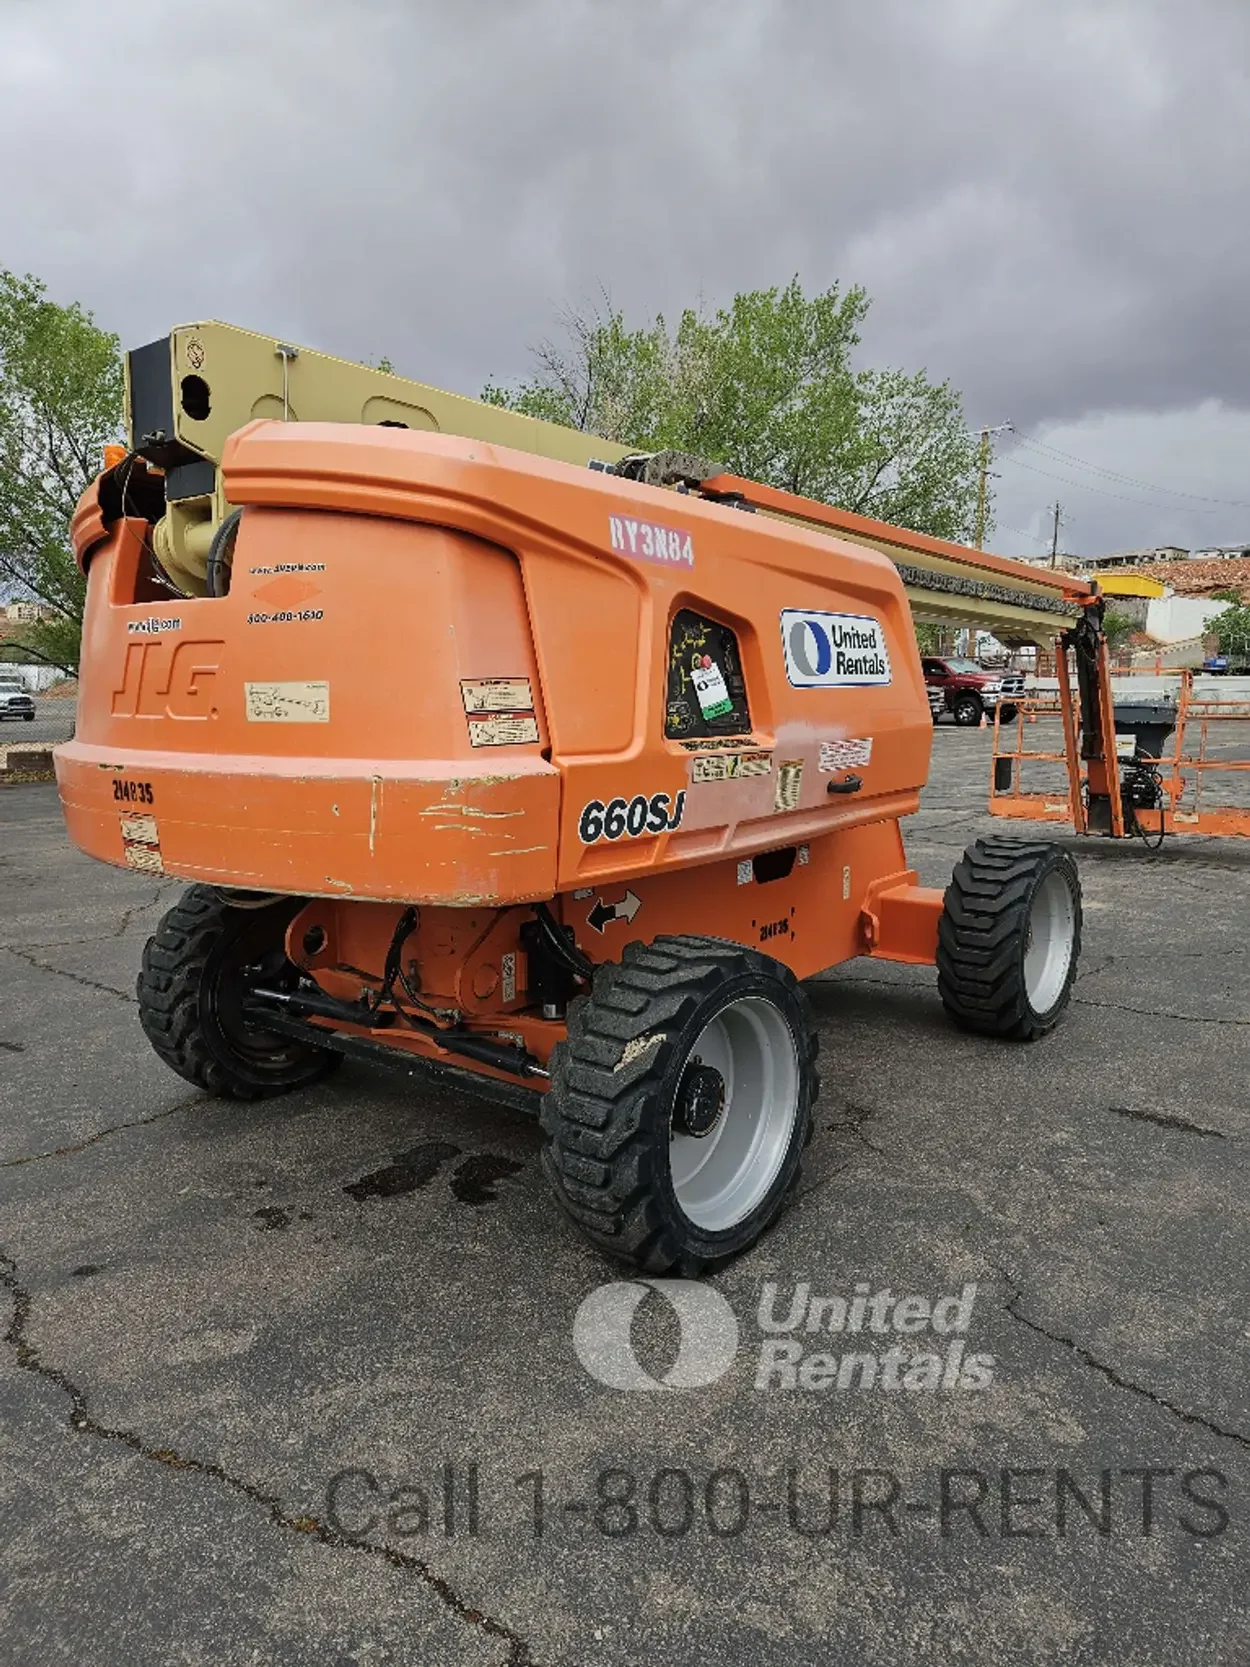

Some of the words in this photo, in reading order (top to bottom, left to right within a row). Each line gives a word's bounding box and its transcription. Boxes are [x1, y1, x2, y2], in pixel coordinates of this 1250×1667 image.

[831, 624, 877, 649] United
[836, 651, 885, 675] Rentals
[112, 779, 154, 804] 214835
[578, 790, 687, 844] 660SJ
